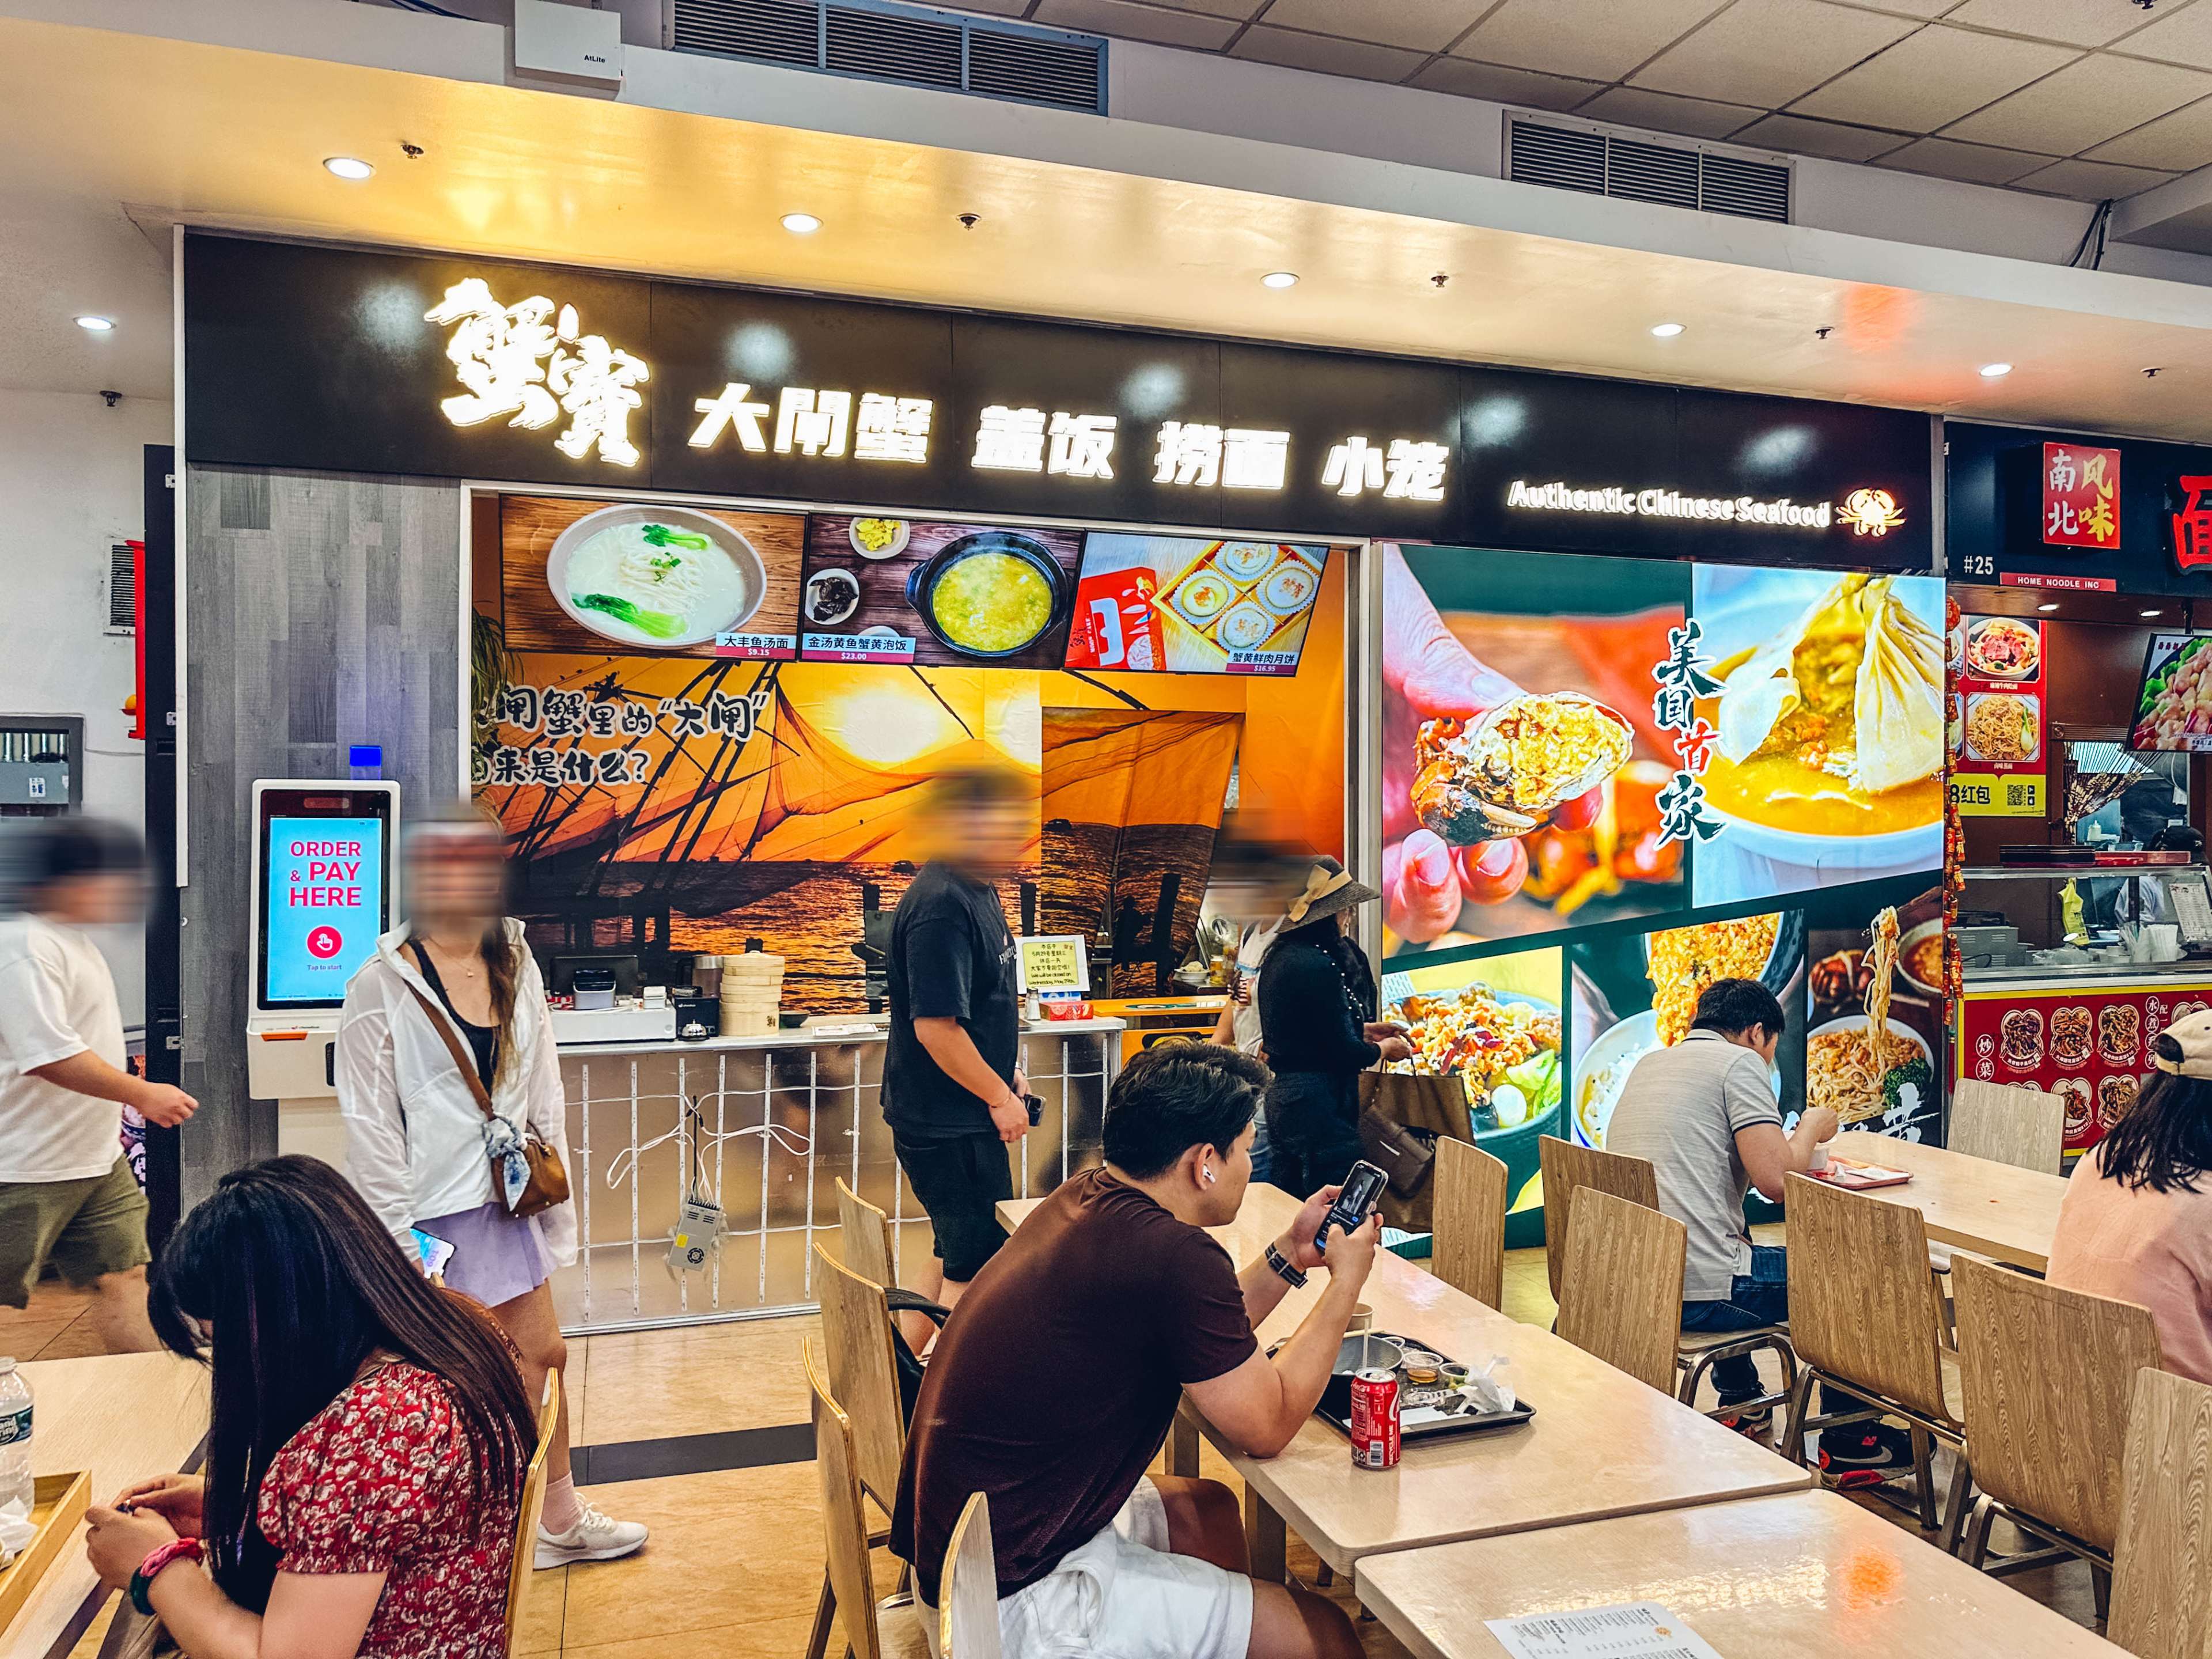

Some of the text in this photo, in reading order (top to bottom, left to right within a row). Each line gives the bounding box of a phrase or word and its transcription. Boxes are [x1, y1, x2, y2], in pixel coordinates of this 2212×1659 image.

[584, 55, 605, 63] AtLite
[1506, 480, 1831, 528] Authentic Chinese Seafood
[1964, 555, 1994, 575] #25
[2017, 576, 2099, 589] HOME NOODLE INC
[724, 635, 789, 649] 大丰鱼汤面
[808, 636, 907, 651] 金汤黄鱼蟹黄泡饭
[747, 648, 770, 657] $9.15
[841, 652, 867, 661] $23.00
[1233, 652, 1294, 665] 蟹黄鲜肉月饼
[1253, 664, 1276, 672] $16.95
[1654, 621, 1728, 847] 美国首家
[1950, 784, 1990, 804] 8红包
[290, 841, 362, 857] ORDER
[290, 862, 361, 882] & PAY
[290, 887, 362, 907] HERE
[1979, 1038, 1993, 1077] 炒菜
